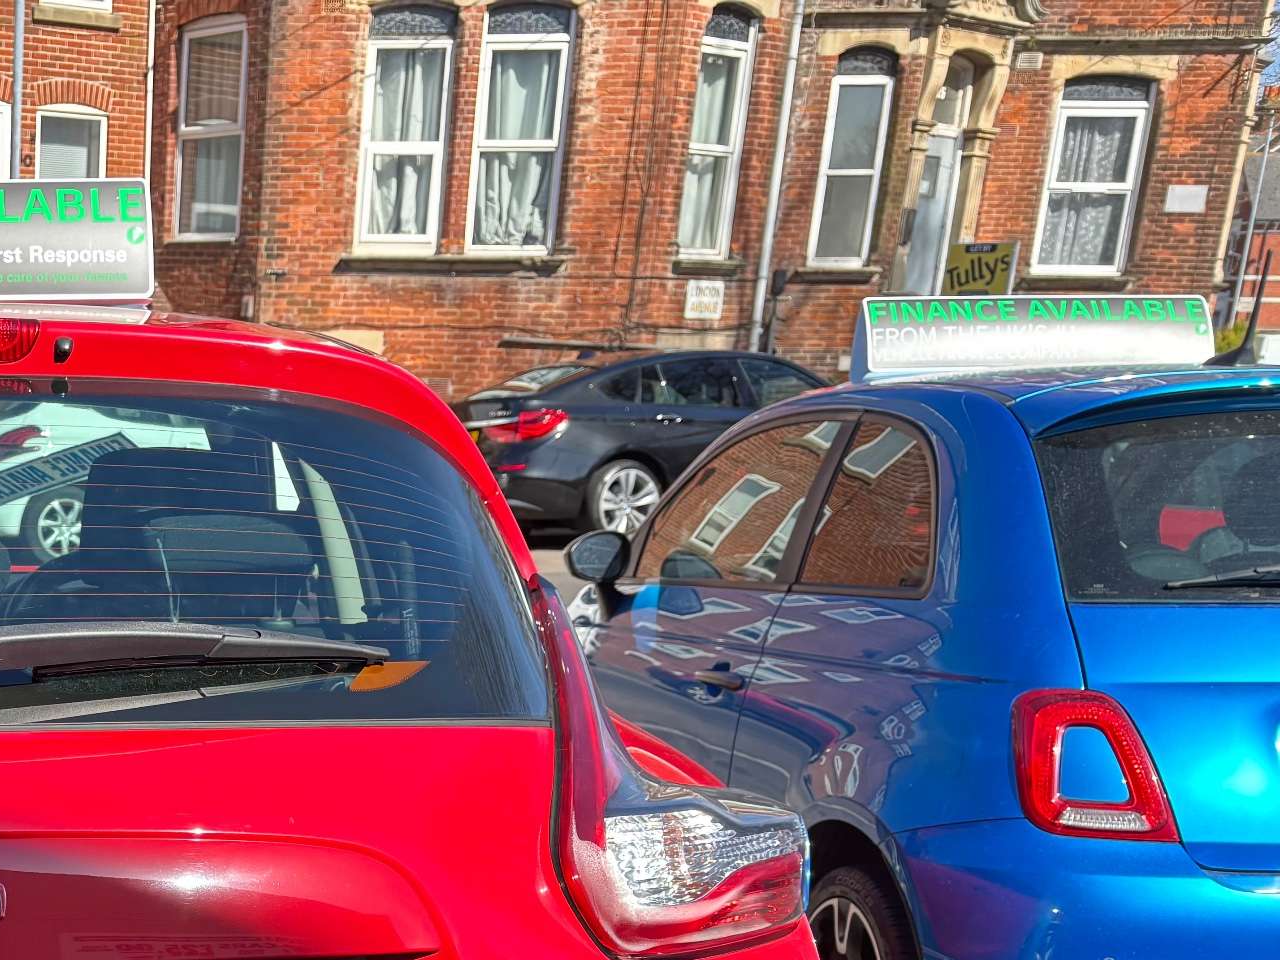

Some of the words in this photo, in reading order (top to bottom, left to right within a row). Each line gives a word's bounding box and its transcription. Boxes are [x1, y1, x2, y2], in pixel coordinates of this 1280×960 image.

[29, 245, 128, 267] Response
[7, 272, 32, 283] care
[36, 271, 49, 282] of
[946, 254, 1010, 289] Tullys
[869, 300, 1018, 325] FINANCE
[1028, 300, 1209, 322] AVAILABLE
[873, 326, 937, 347] FROM
